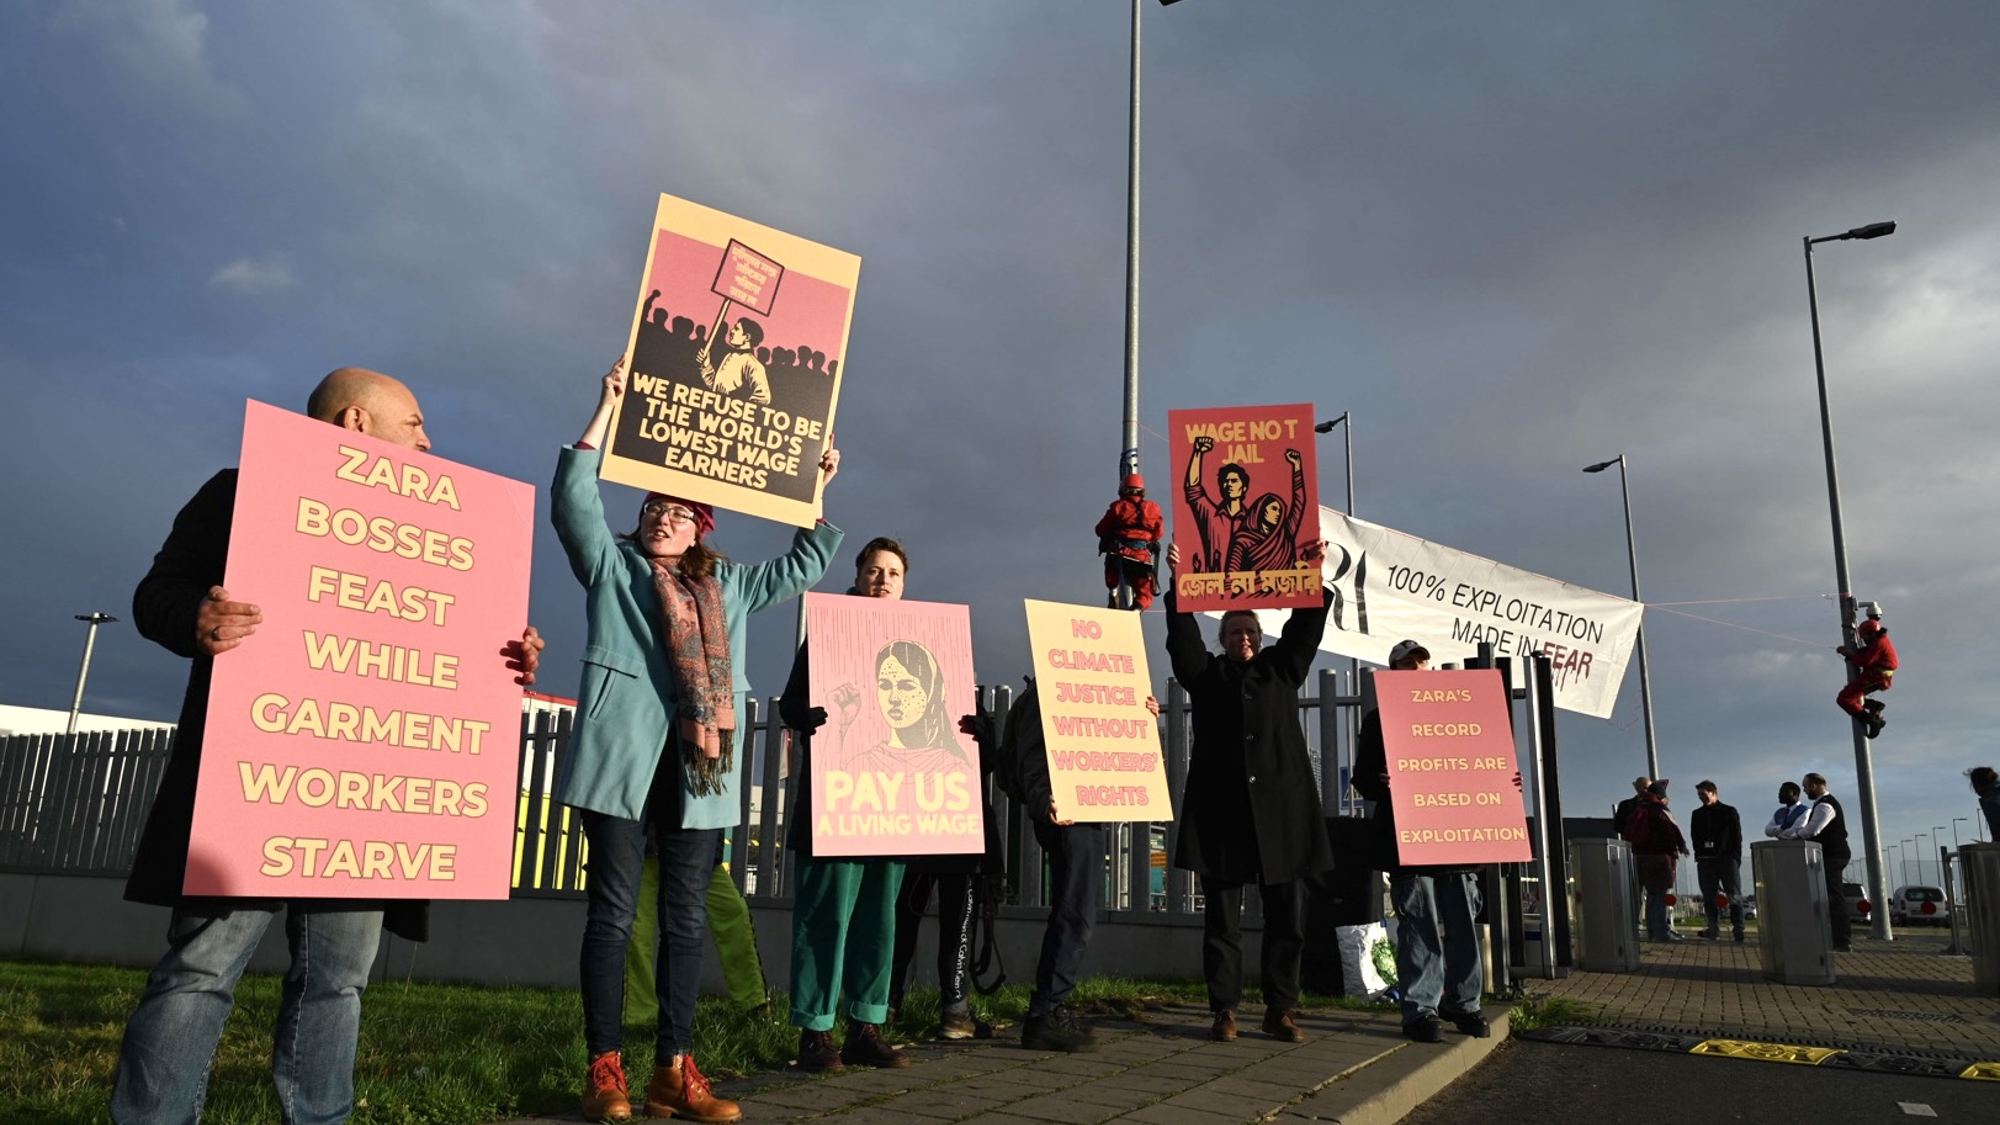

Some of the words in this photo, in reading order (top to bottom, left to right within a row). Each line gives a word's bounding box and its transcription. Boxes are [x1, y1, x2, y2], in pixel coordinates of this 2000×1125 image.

[633, 372, 668, 399] WE
[672, 383, 757, 421] REFUSE
[762, 407, 791, 431] TO
[795, 416, 823, 441] BE
[645, 397, 691, 427] THE
[698, 411, 803, 456] WORLD'S
[1185, 421, 1246, 444] WAGE
[638, 418, 733, 458] LOWEST
[737, 443, 800, 477] WAGE
[1222, 444, 1264, 464] JAIL
[336, 444, 462, 512] ZARA
[664, 448, 768, 489] EARNERS
[295, 496, 474, 572] BOSSES
[307, 565, 455, 627] FEAST
[1178, 572, 1225, 597] জেল
[1228, 570, 1258, 594] না
[1260, 560, 1320, 597] মজুরি
[1387, 564, 1445, 602] 100%
[1452, 583, 1604, 645] EXPLOITATION
[1071, 618, 1102, 640] NO
[302, 629, 460, 690] WHILE
[1048, 648, 1135, 674] CLIMATE
[1452, 617, 1514, 655] MADE
[1518, 635, 1540, 658] IN
[1541, 641, 1593, 684] FEAR
[1055, 682, 1137, 707] JUSTICE
[1411, 689, 1472, 703] ZARA'S
[250, 692, 491, 755] GARMENT
[1052, 715, 1148, 739] WITHOUT
[1411, 723, 1482, 737] RECORD
[1050, 749, 1157, 773] WORKERS'
[1398, 758, 1469, 772] PROFITS
[1473, 757, 1508, 770] ARE
[237, 761, 490, 819] WORKERS
[825, 770, 906, 812] PAY
[913, 771, 971, 812] US
[1076, 785, 1149, 807] RIGHTS
[1414, 793, 1471, 807] BASED
[1476, 792, 1502, 806] ON
[816, 815, 833, 836] A
[839, 815, 914, 835] LIVING
[919, 814, 980, 835] WAGE
[1400, 827, 1526, 844] EXPLOITATION
[260, 835, 458, 881] STARVE
